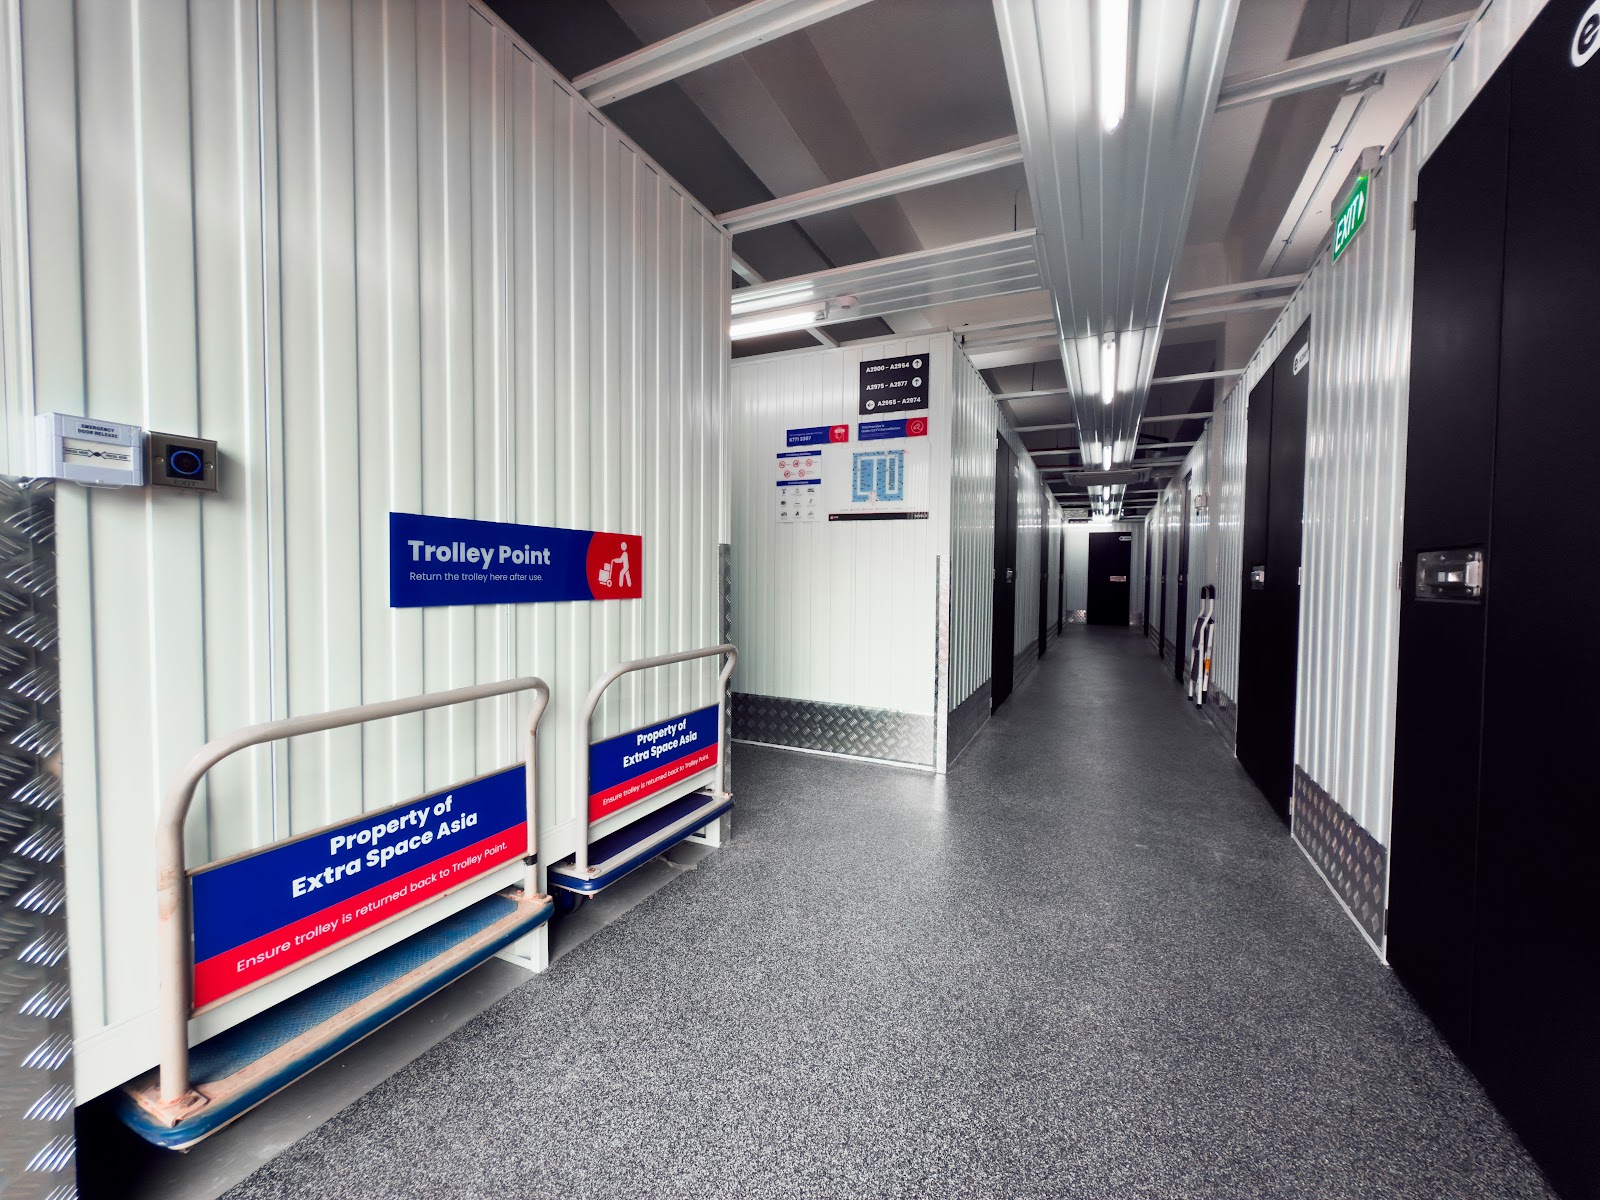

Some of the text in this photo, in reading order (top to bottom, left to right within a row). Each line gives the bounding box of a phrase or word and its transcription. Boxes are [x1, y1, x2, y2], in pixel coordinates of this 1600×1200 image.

[1334, 194, 1360, 253] EXIT
[866, 365, 885, 373] A2900
[890, 362, 910, 370] A2954
[866, 383, 884, 391] A2975
[889, 380, 908, 388] A2977
[81, 424, 115, 433] EMERGENCY
[174, 479, 197, 487] EXIT
[408, 540, 551, 570] Trolley Point
[409, 572, 442, 581] Return
[444, 572, 459, 581] the
[461, 572, 488, 583] trolley
[489, 572, 507, 581] here
[509, 573, 527, 581] after
[637, 718, 687, 746] Property of
[623, 731, 698, 768] Extra Space Asia
[602, 793, 622, 806] Ensure
[623, 784, 640, 796] trolley
[640, 781, 645, 789] is
[645, 771, 667, 786] returned
[667, 766, 679, 777] back
[685, 759, 698, 769] Trolley
[330, 794, 454, 856] Property of
[291, 810, 478, 898] Extra Space Asia
[236, 841, 508, 973] Ensure trolley is returned back to Trolley Point.
